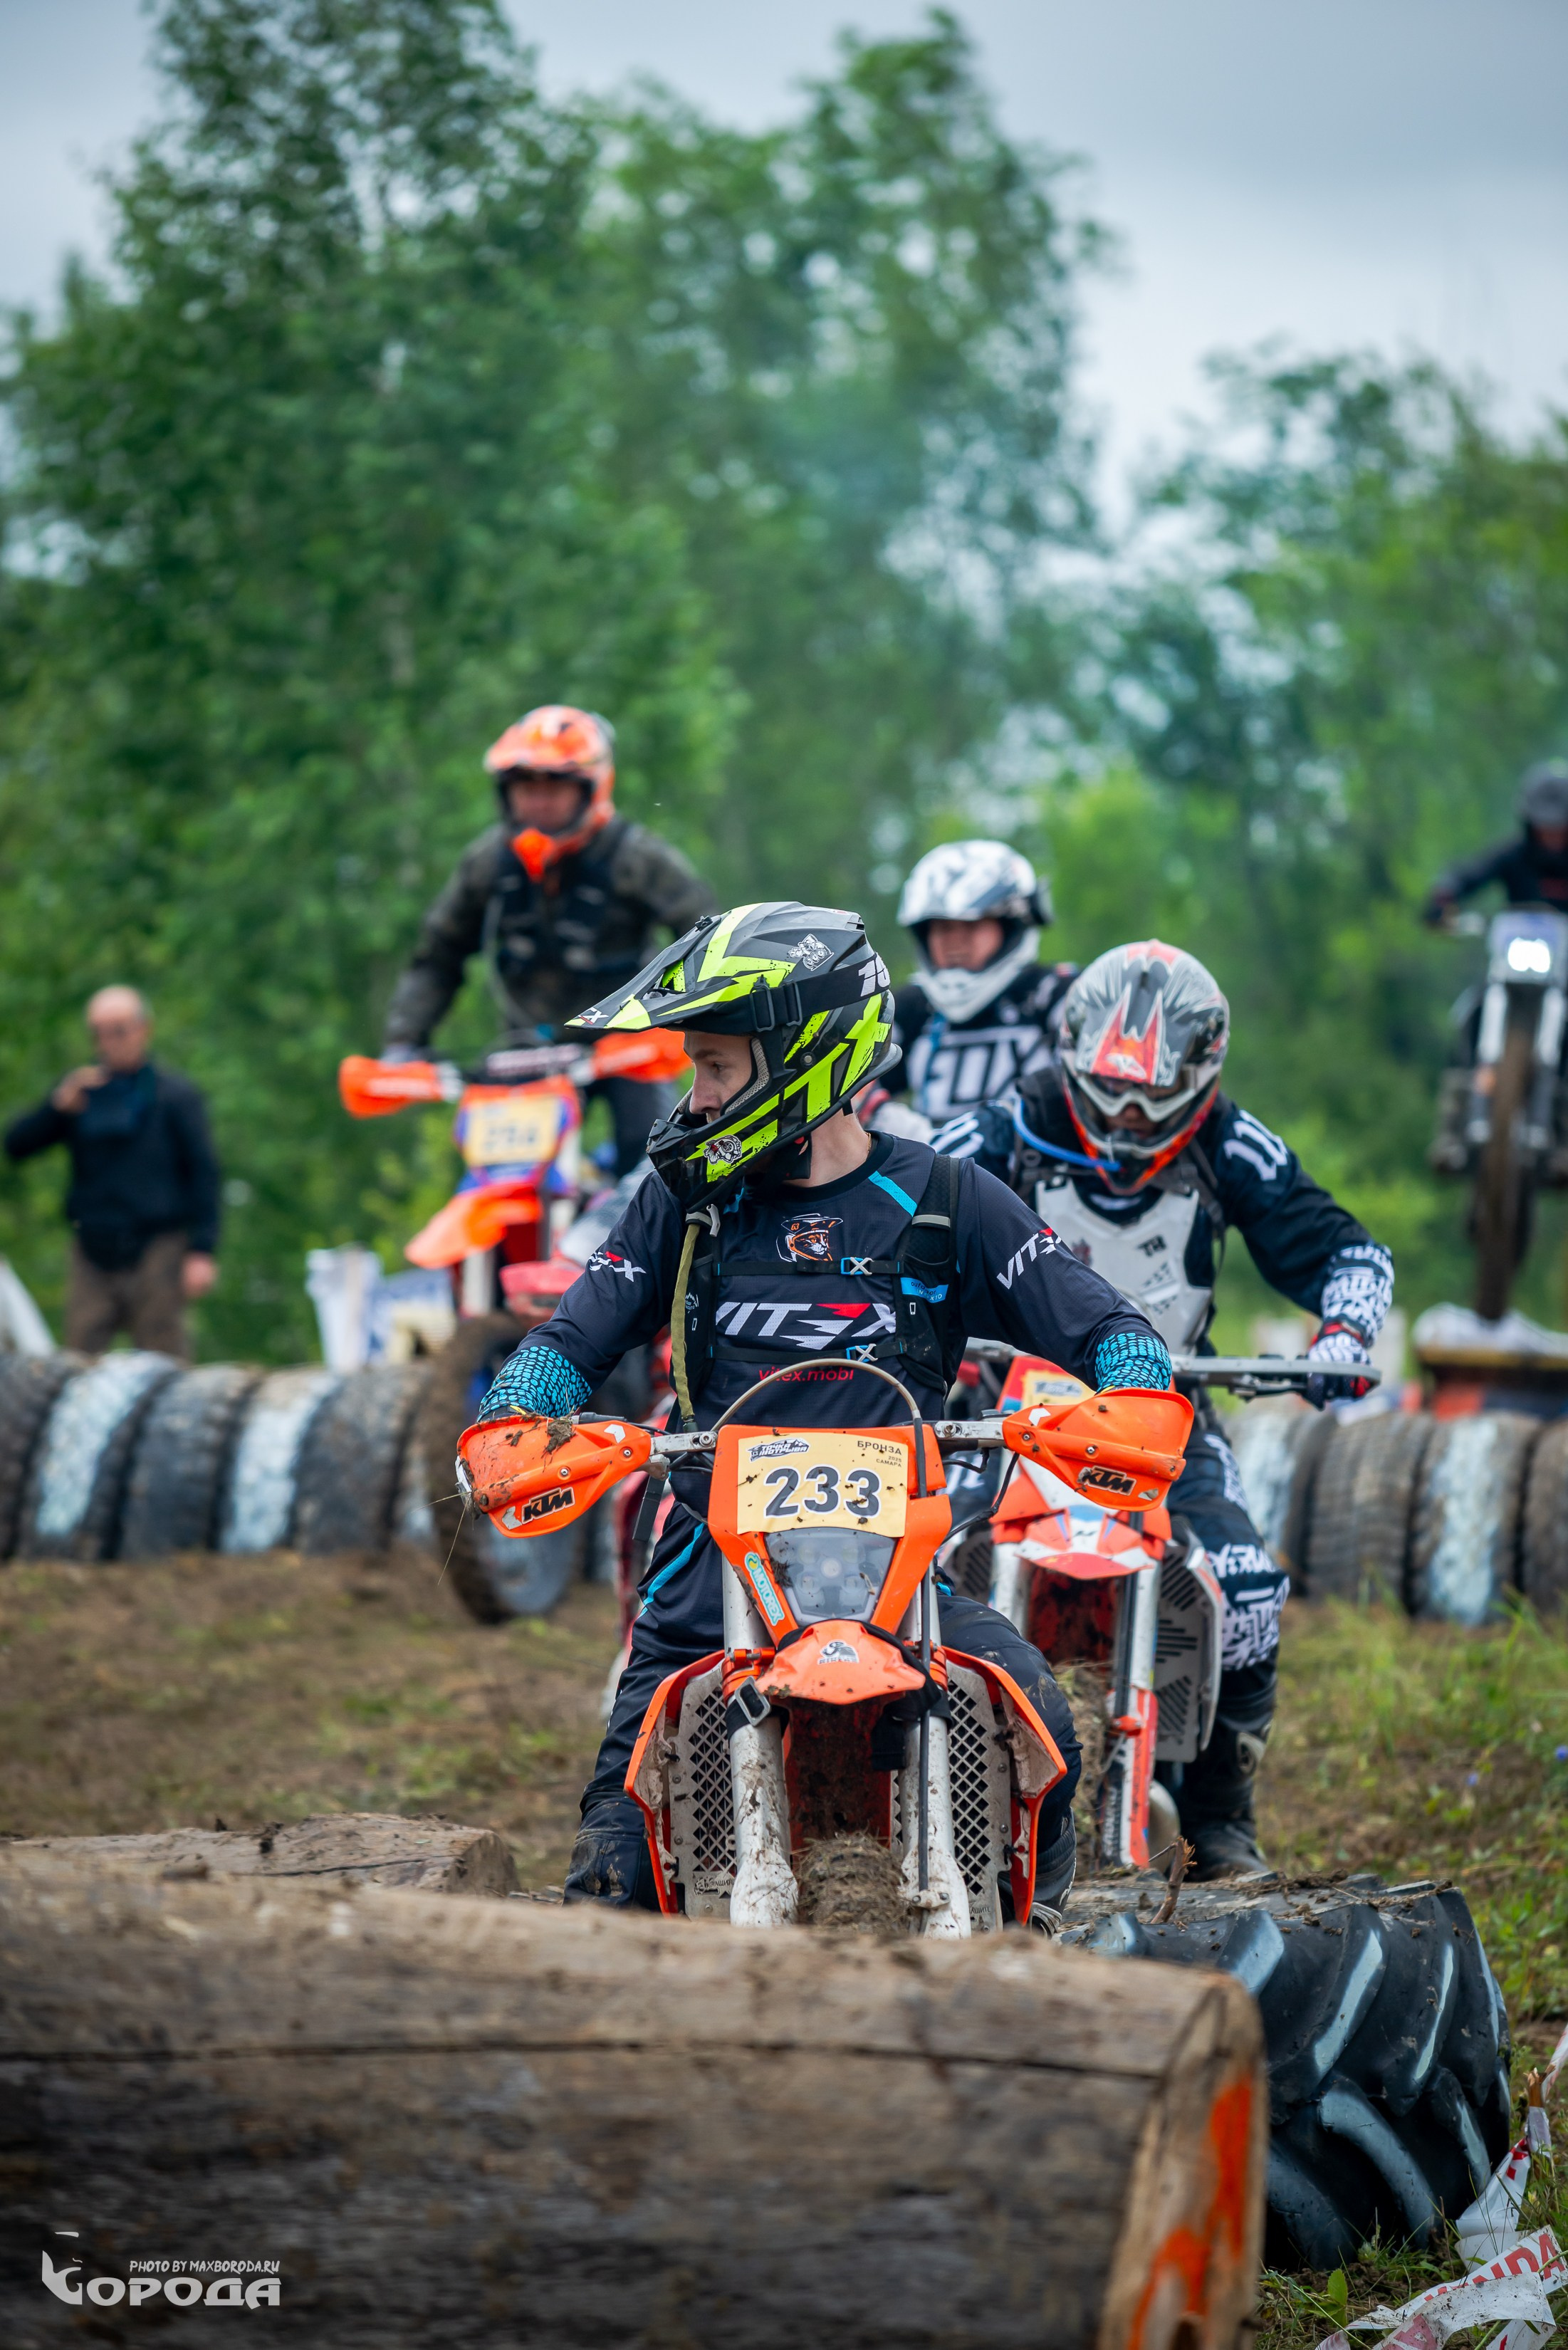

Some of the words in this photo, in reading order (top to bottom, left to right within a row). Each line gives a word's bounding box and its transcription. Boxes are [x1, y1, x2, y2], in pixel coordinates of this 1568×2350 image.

[857, 1440, 903, 1456] БРОНЗА
[876, 1458, 903, 1468] САМАРА
[764, 1464, 882, 1518] 233
[1081, 1466, 1136, 1496] KTM
[522, 1486, 575, 1524] KTM
[751, 1567, 784, 1624] MOTOREX
